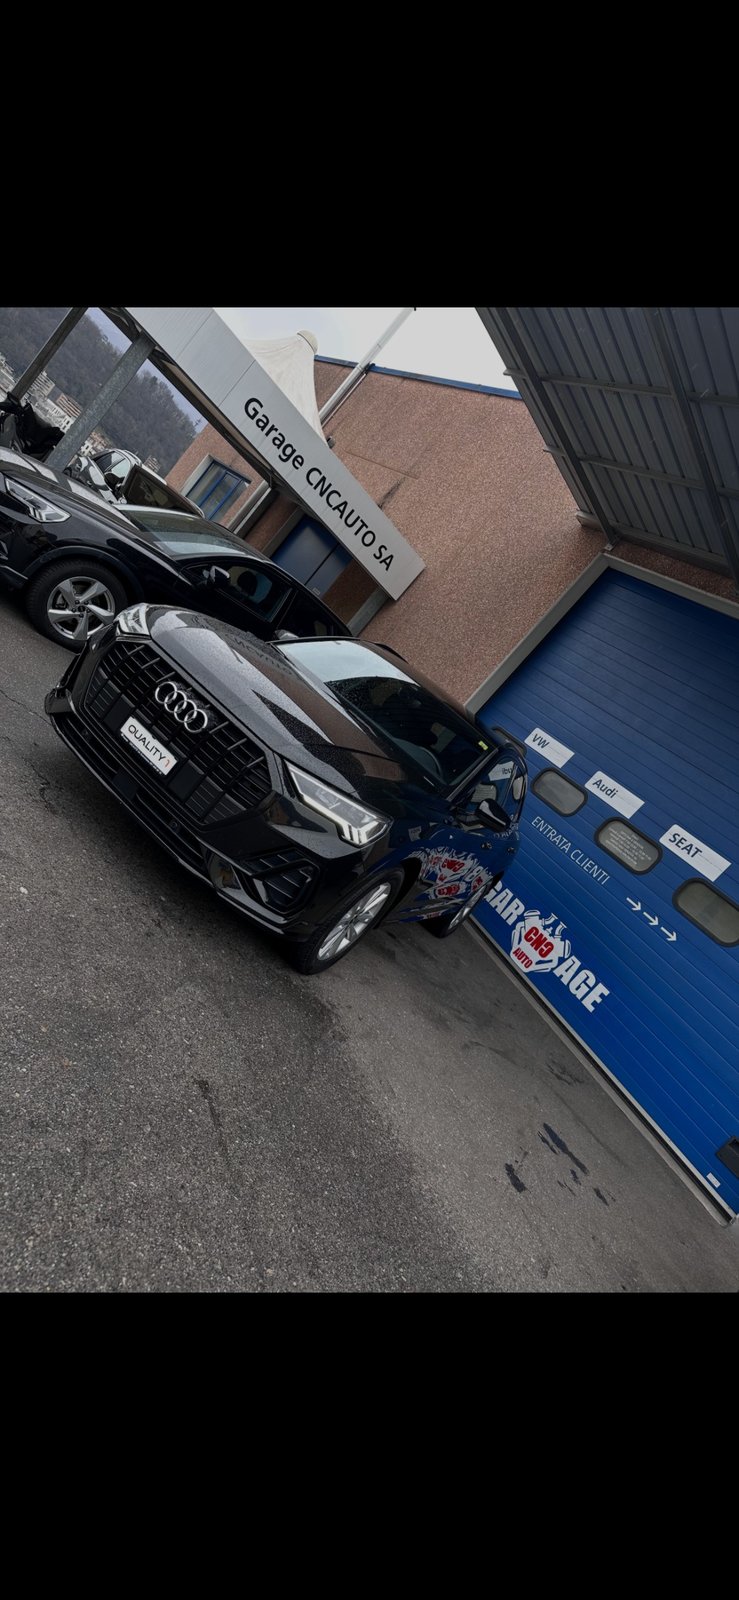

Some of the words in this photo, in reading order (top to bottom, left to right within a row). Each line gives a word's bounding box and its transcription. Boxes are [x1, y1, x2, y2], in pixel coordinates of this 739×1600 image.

[244, 397, 304, 469] Garage
[305, 467, 376, 548] CNCAUTO
[373, 544, 394, 571] SA
[532, 733, 549, 749] VW
[592, 778, 619, 798] Audi
[531, 816, 571, 853] ENTRATA
[570, 849, 610, 885] CLIENTI
[668, 832, 702, 859] SEAT
[512, 947, 533, 968] AUTO
[553, 955, 610, 1013] AGE
